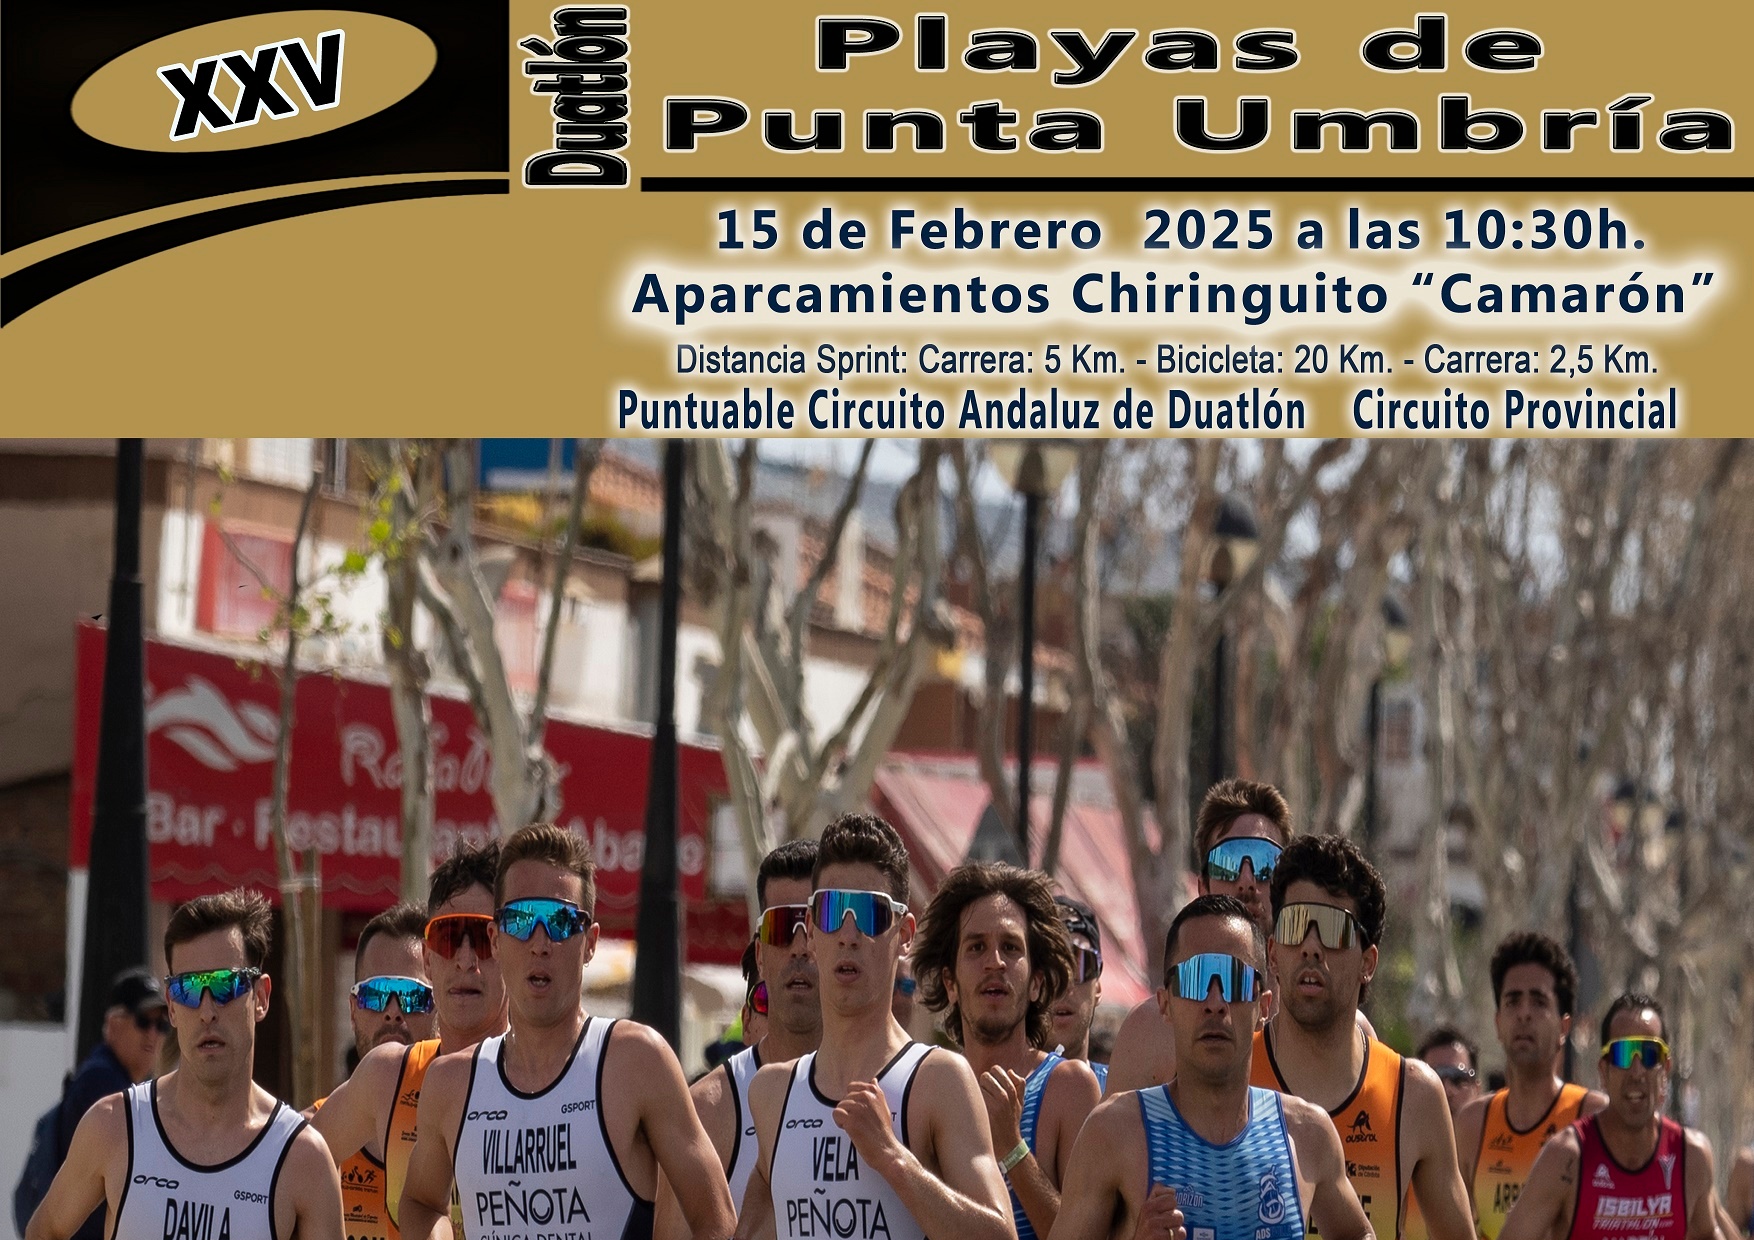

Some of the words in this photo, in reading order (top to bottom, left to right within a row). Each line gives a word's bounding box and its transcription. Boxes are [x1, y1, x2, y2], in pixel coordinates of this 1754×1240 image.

[146, 792, 226, 848] Bar
[467, 1110, 508, 1121] orca
[561, 1100, 595, 1114] GSPORT
[786, 1118, 823, 1129] orca
[483, 1123, 577, 1175] VILLARRUEL
[813, 1136, 859, 1182] VELA
[133, 1174, 179, 1189] orca
[233, 1190, 268, 1205] GSPORT
[476, 1180, 591, 1227] PEÑOTA
